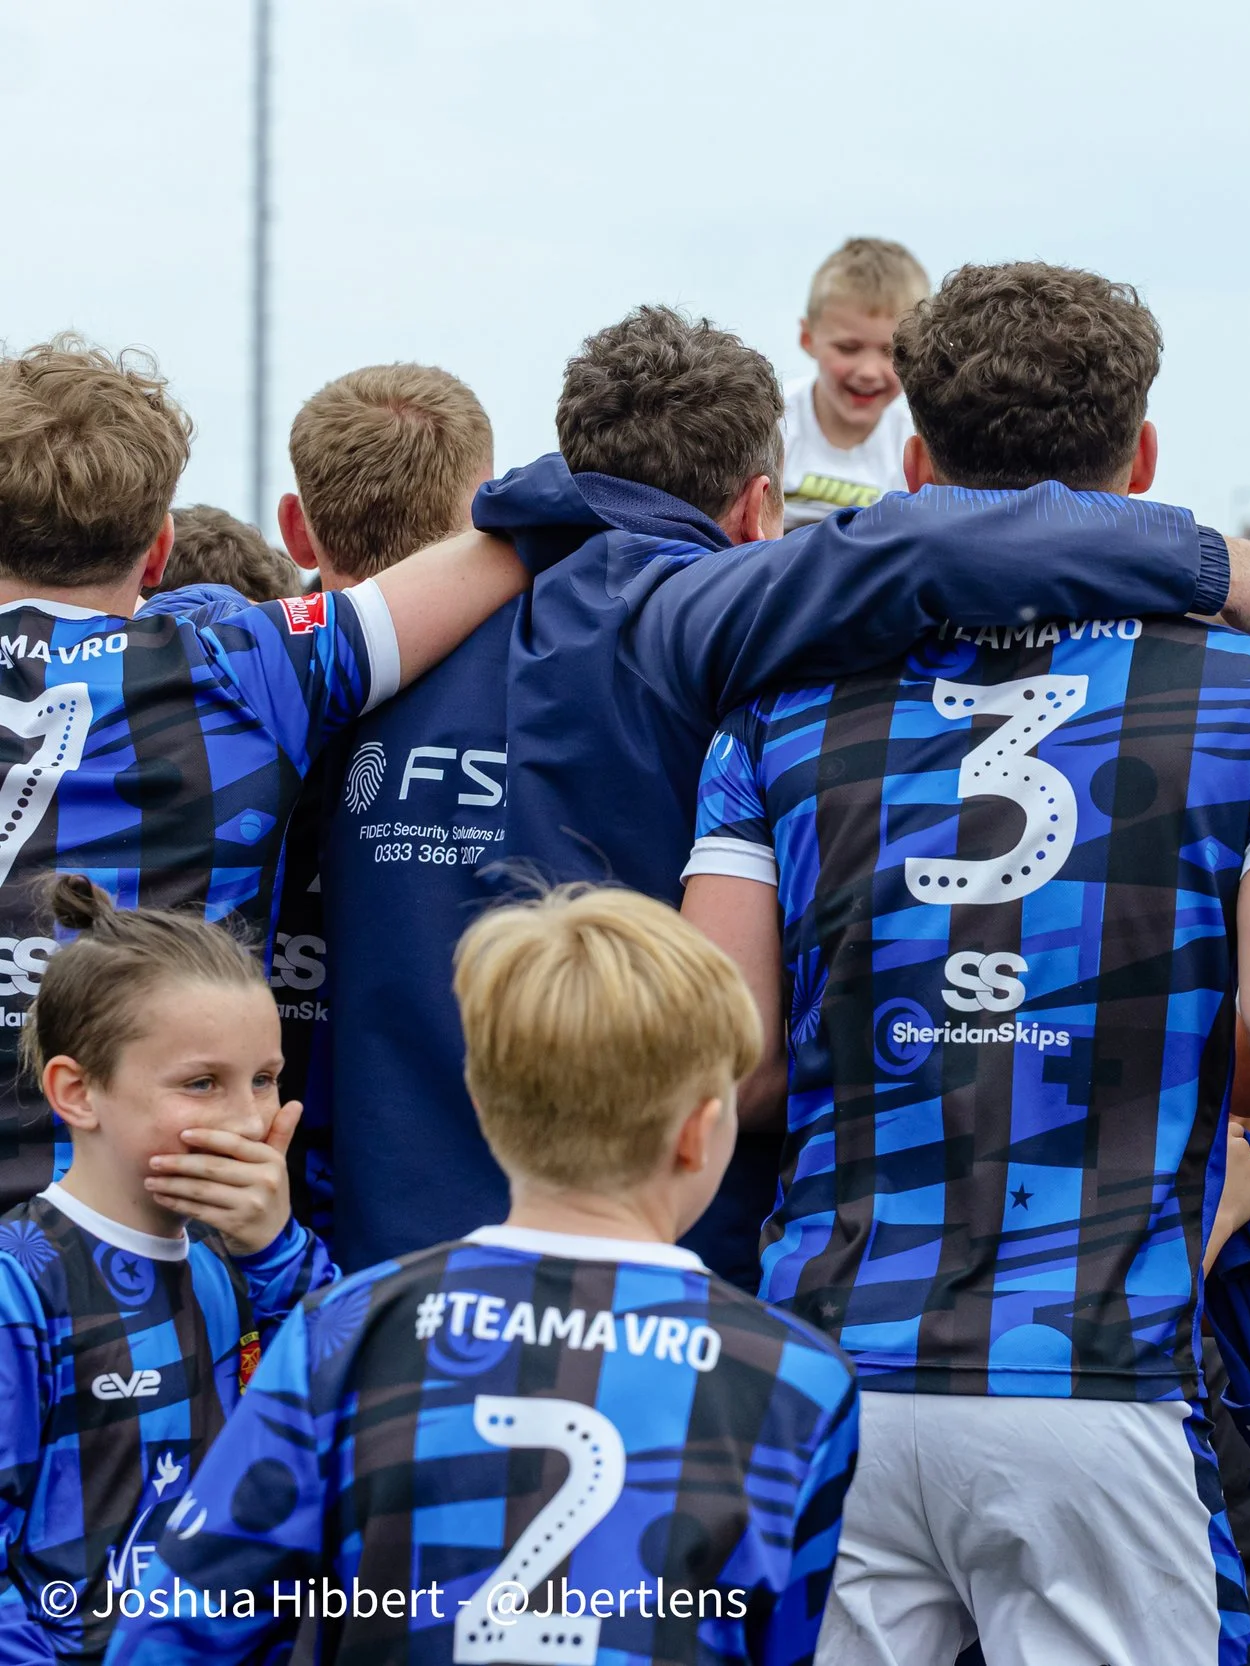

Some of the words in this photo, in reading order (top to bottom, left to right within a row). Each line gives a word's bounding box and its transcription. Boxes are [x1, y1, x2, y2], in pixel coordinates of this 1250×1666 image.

[399, 743, 508, 807] FS
[905, 674, 1089, 905] 3
[359, 823, 391, 839] FIDEC
[393, 822, 449, 843] Security
[452, 825, 493, 841] Solutions
[375, 843, 412, 863] 0333
[418, 844, 458, 865] 366
[941, 951, 1028, 1012] SS
[892, 1021, 1070, 1051] SheridanSkips
[415, 1291, 721, 1372] #TEAMAVRO
[453, 1394, 626, 1665] 2
